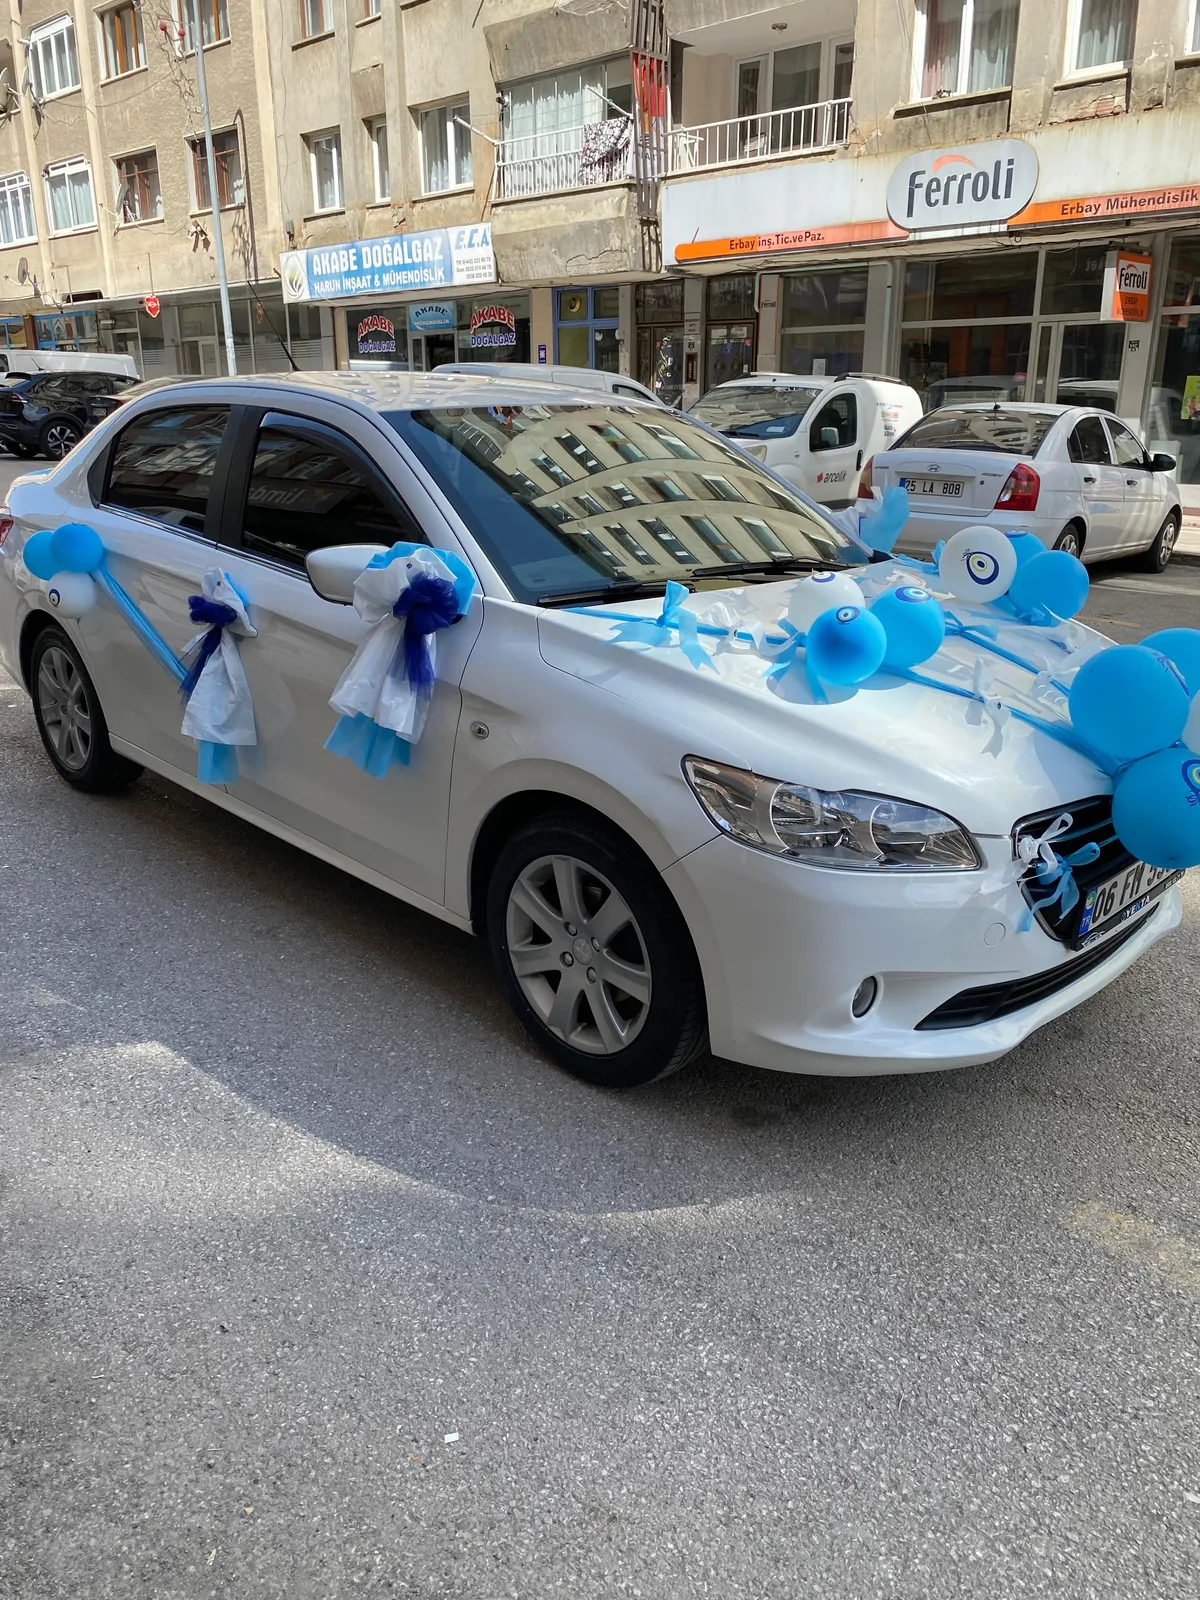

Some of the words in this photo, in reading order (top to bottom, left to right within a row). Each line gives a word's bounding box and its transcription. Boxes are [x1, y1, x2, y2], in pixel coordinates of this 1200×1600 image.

[1060, 203, 1101, 216] Erbay
[1106, 189, 1199, 212] Mühendislik
[312, 248, 358, 275] AKABE
[361, 237, 443, 270] DOĞALGAZ
[729, 239, 756, 251] Erbay
[313, 279, 341, 292] HARUN
[342, 274, 371, 293] İNŞAAT
[374, 273, 380, 287] &
[382, 265, 445, 286] MÜHENDİSLİK
[414, 305, 448, 318] AKABE
[470, 305, 516, 334] AKABE
[357, 315, 396, 342] AKABE
[470, 332, 517, 348] DOĞALGAZ
[358, 340, 397, 353] DOĞALGAZ
[905, 480, 917, 492] 25
[922, 481, 935, 494] LA
[942, 483, 962, 496] 808
[1092, 881, 1118, 924] 06
